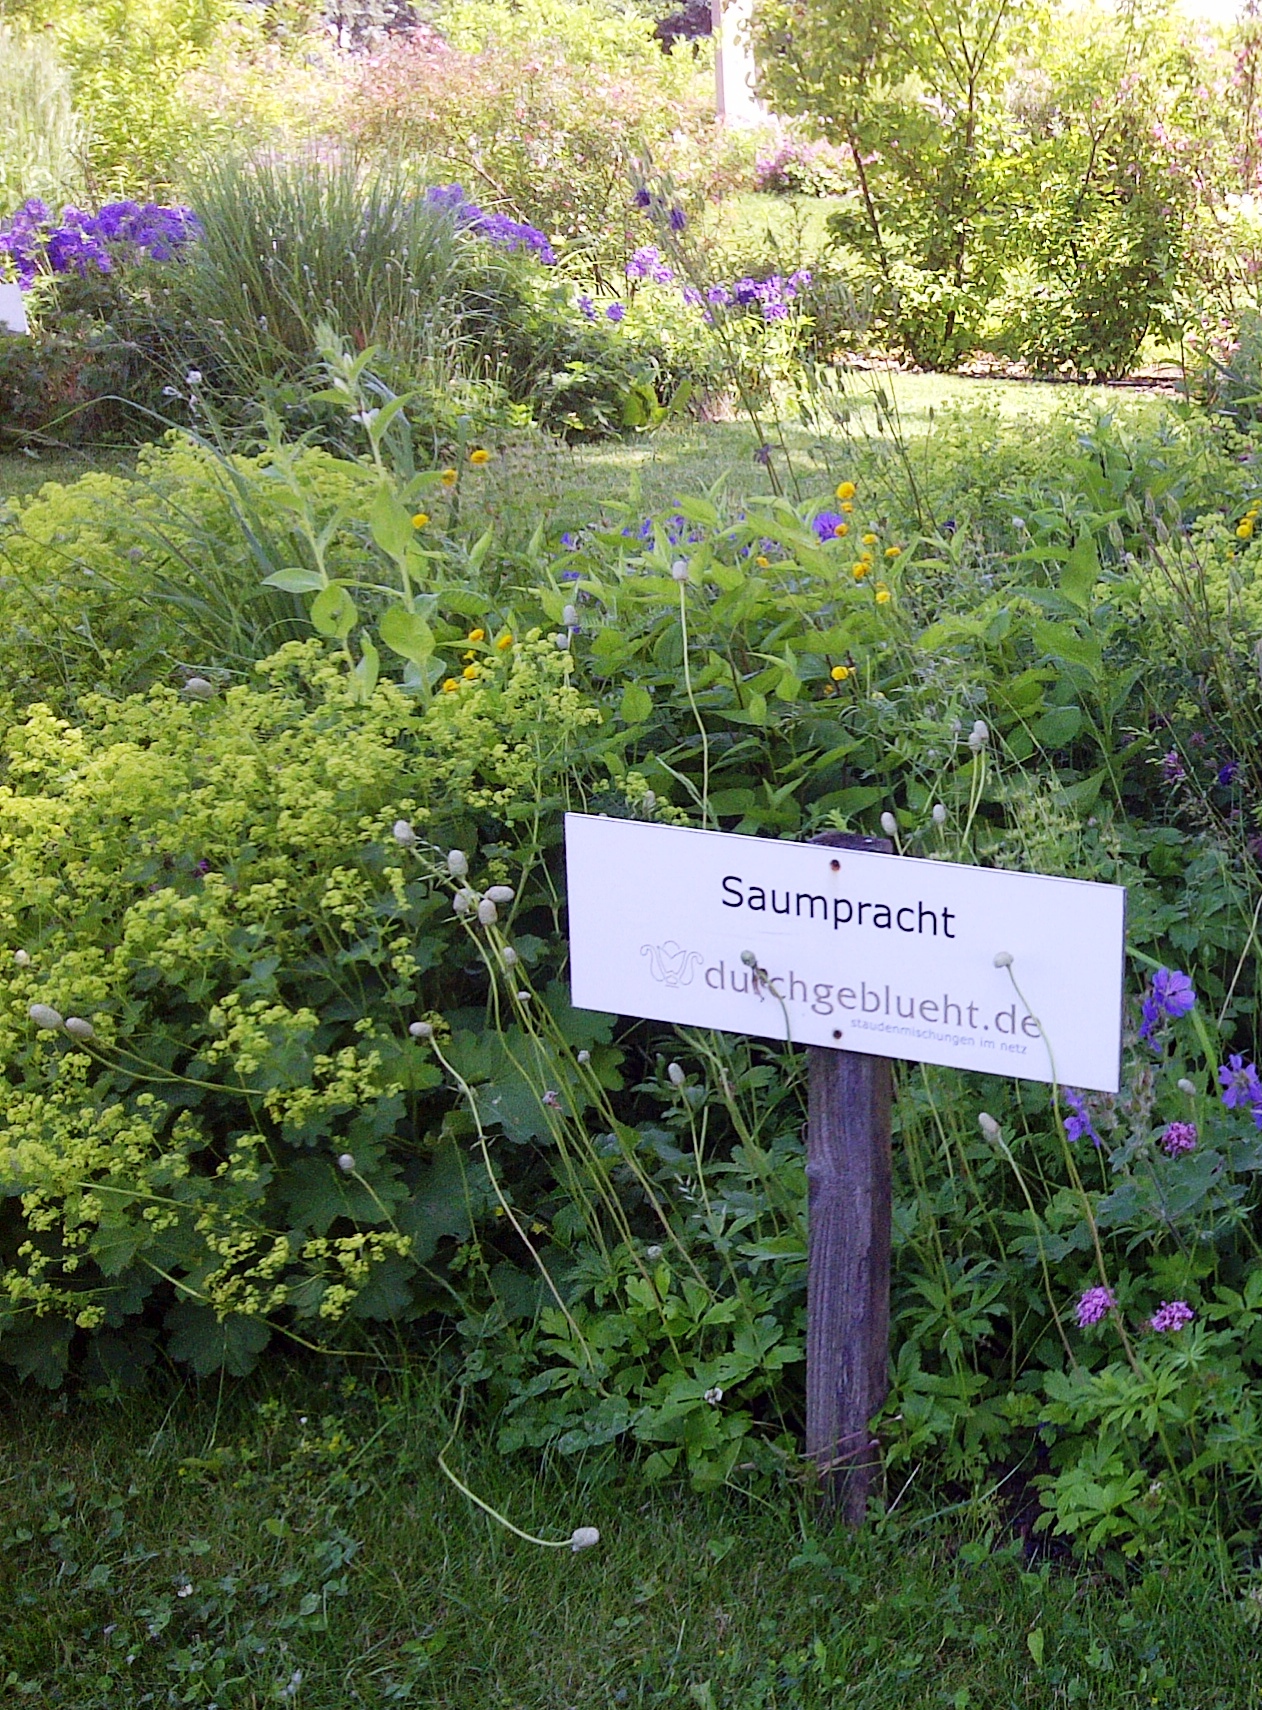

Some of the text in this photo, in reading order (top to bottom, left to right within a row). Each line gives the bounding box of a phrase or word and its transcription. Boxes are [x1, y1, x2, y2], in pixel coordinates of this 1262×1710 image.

[721, 875, 956, 938] Saumpracht
[850, 1017, 1027, 1055] staudenmischungen im netz
